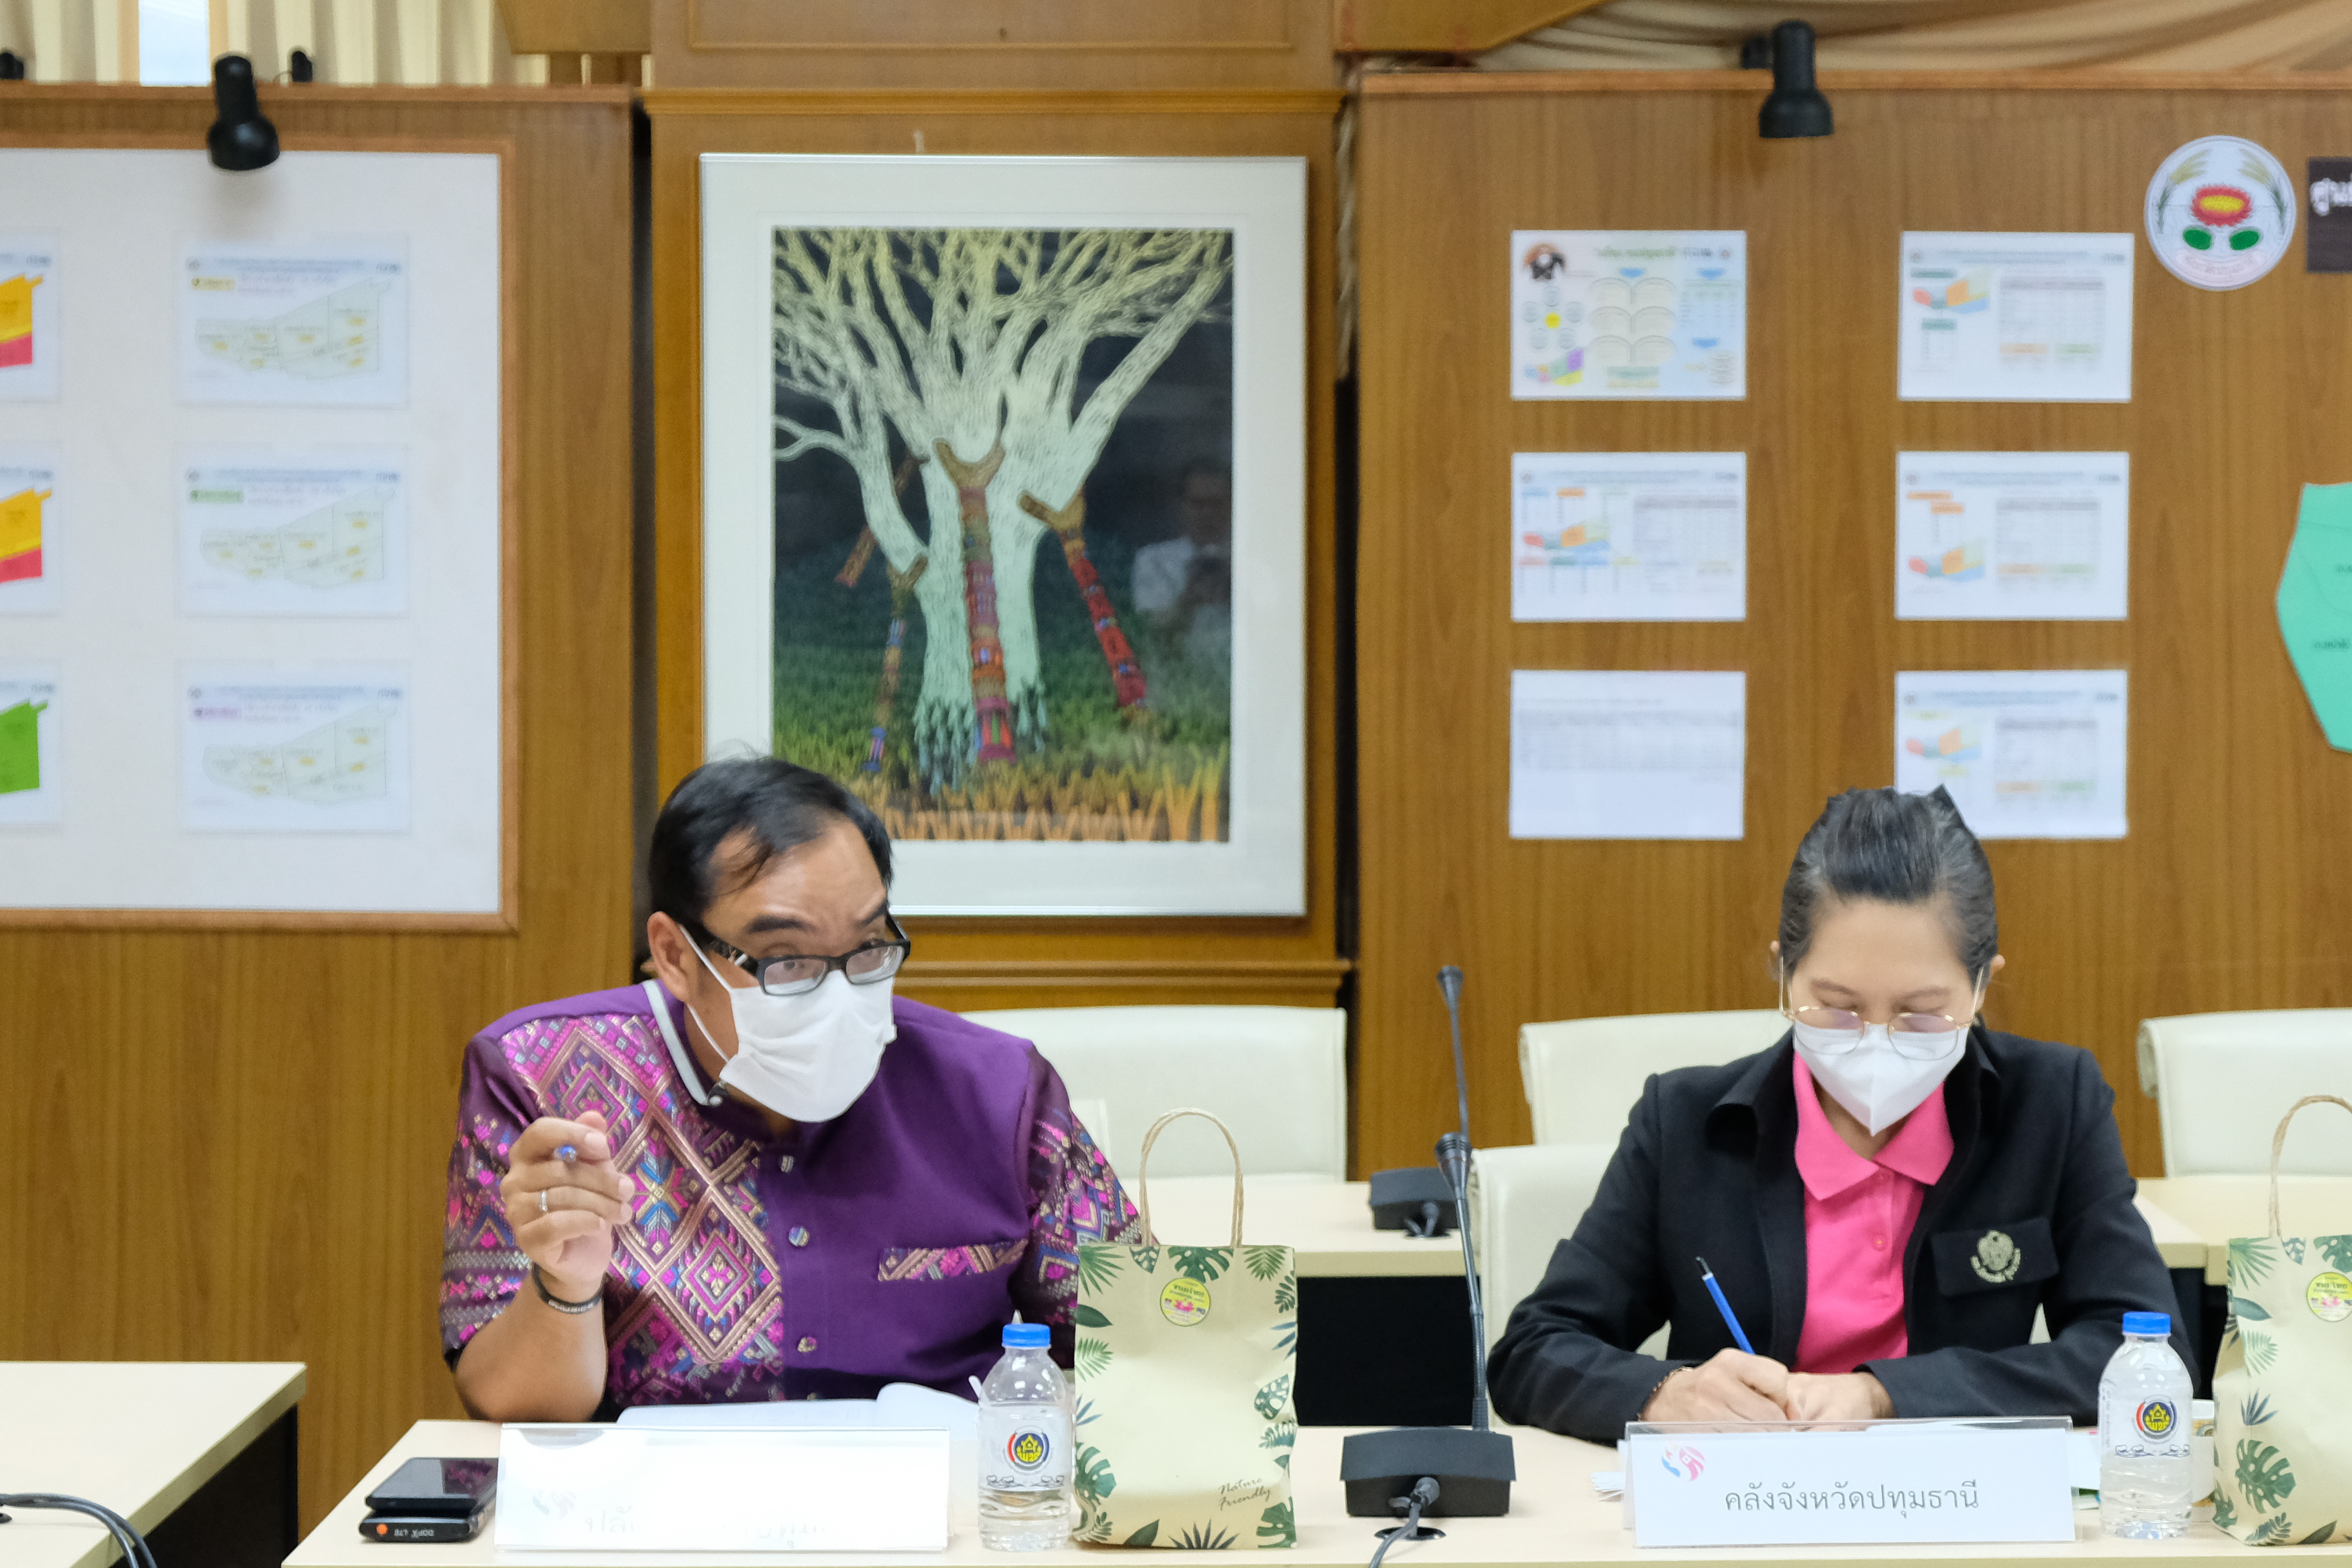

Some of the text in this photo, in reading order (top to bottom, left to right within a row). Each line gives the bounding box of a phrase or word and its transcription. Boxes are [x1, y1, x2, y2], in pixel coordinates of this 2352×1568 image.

[1217, 1485, 1270, 1512] Friendly
[1218, 1477, 1262, 1495] Nature
[1725, 1479, 1979, 1519] คลังจังหวัดปทุมธานี
